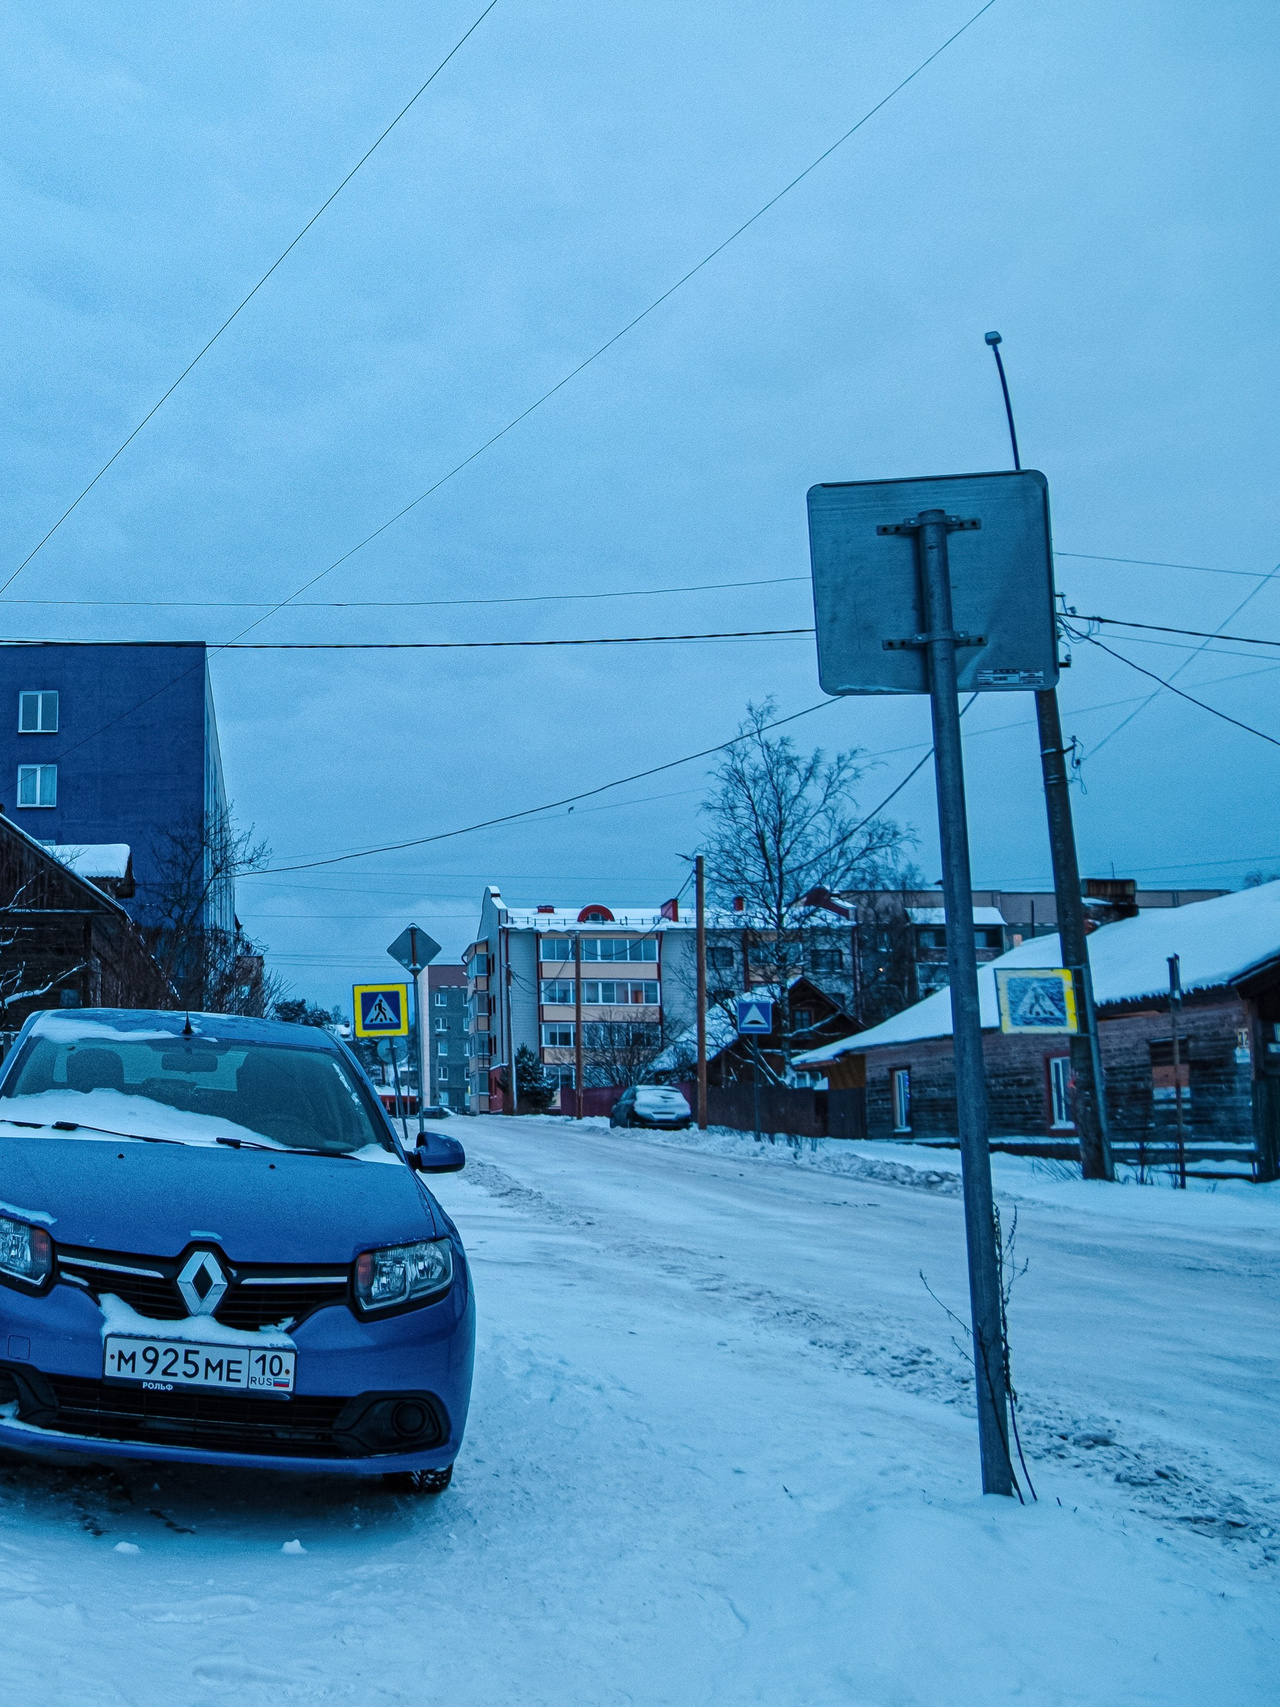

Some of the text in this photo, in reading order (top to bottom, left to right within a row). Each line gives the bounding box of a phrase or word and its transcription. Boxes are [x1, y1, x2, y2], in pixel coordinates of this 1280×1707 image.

[254, 1353, 283, 1376] 10
[250, 1377, 273, 1386] RUS
[142, 1382, 173, 1391] РОЛЬФ
